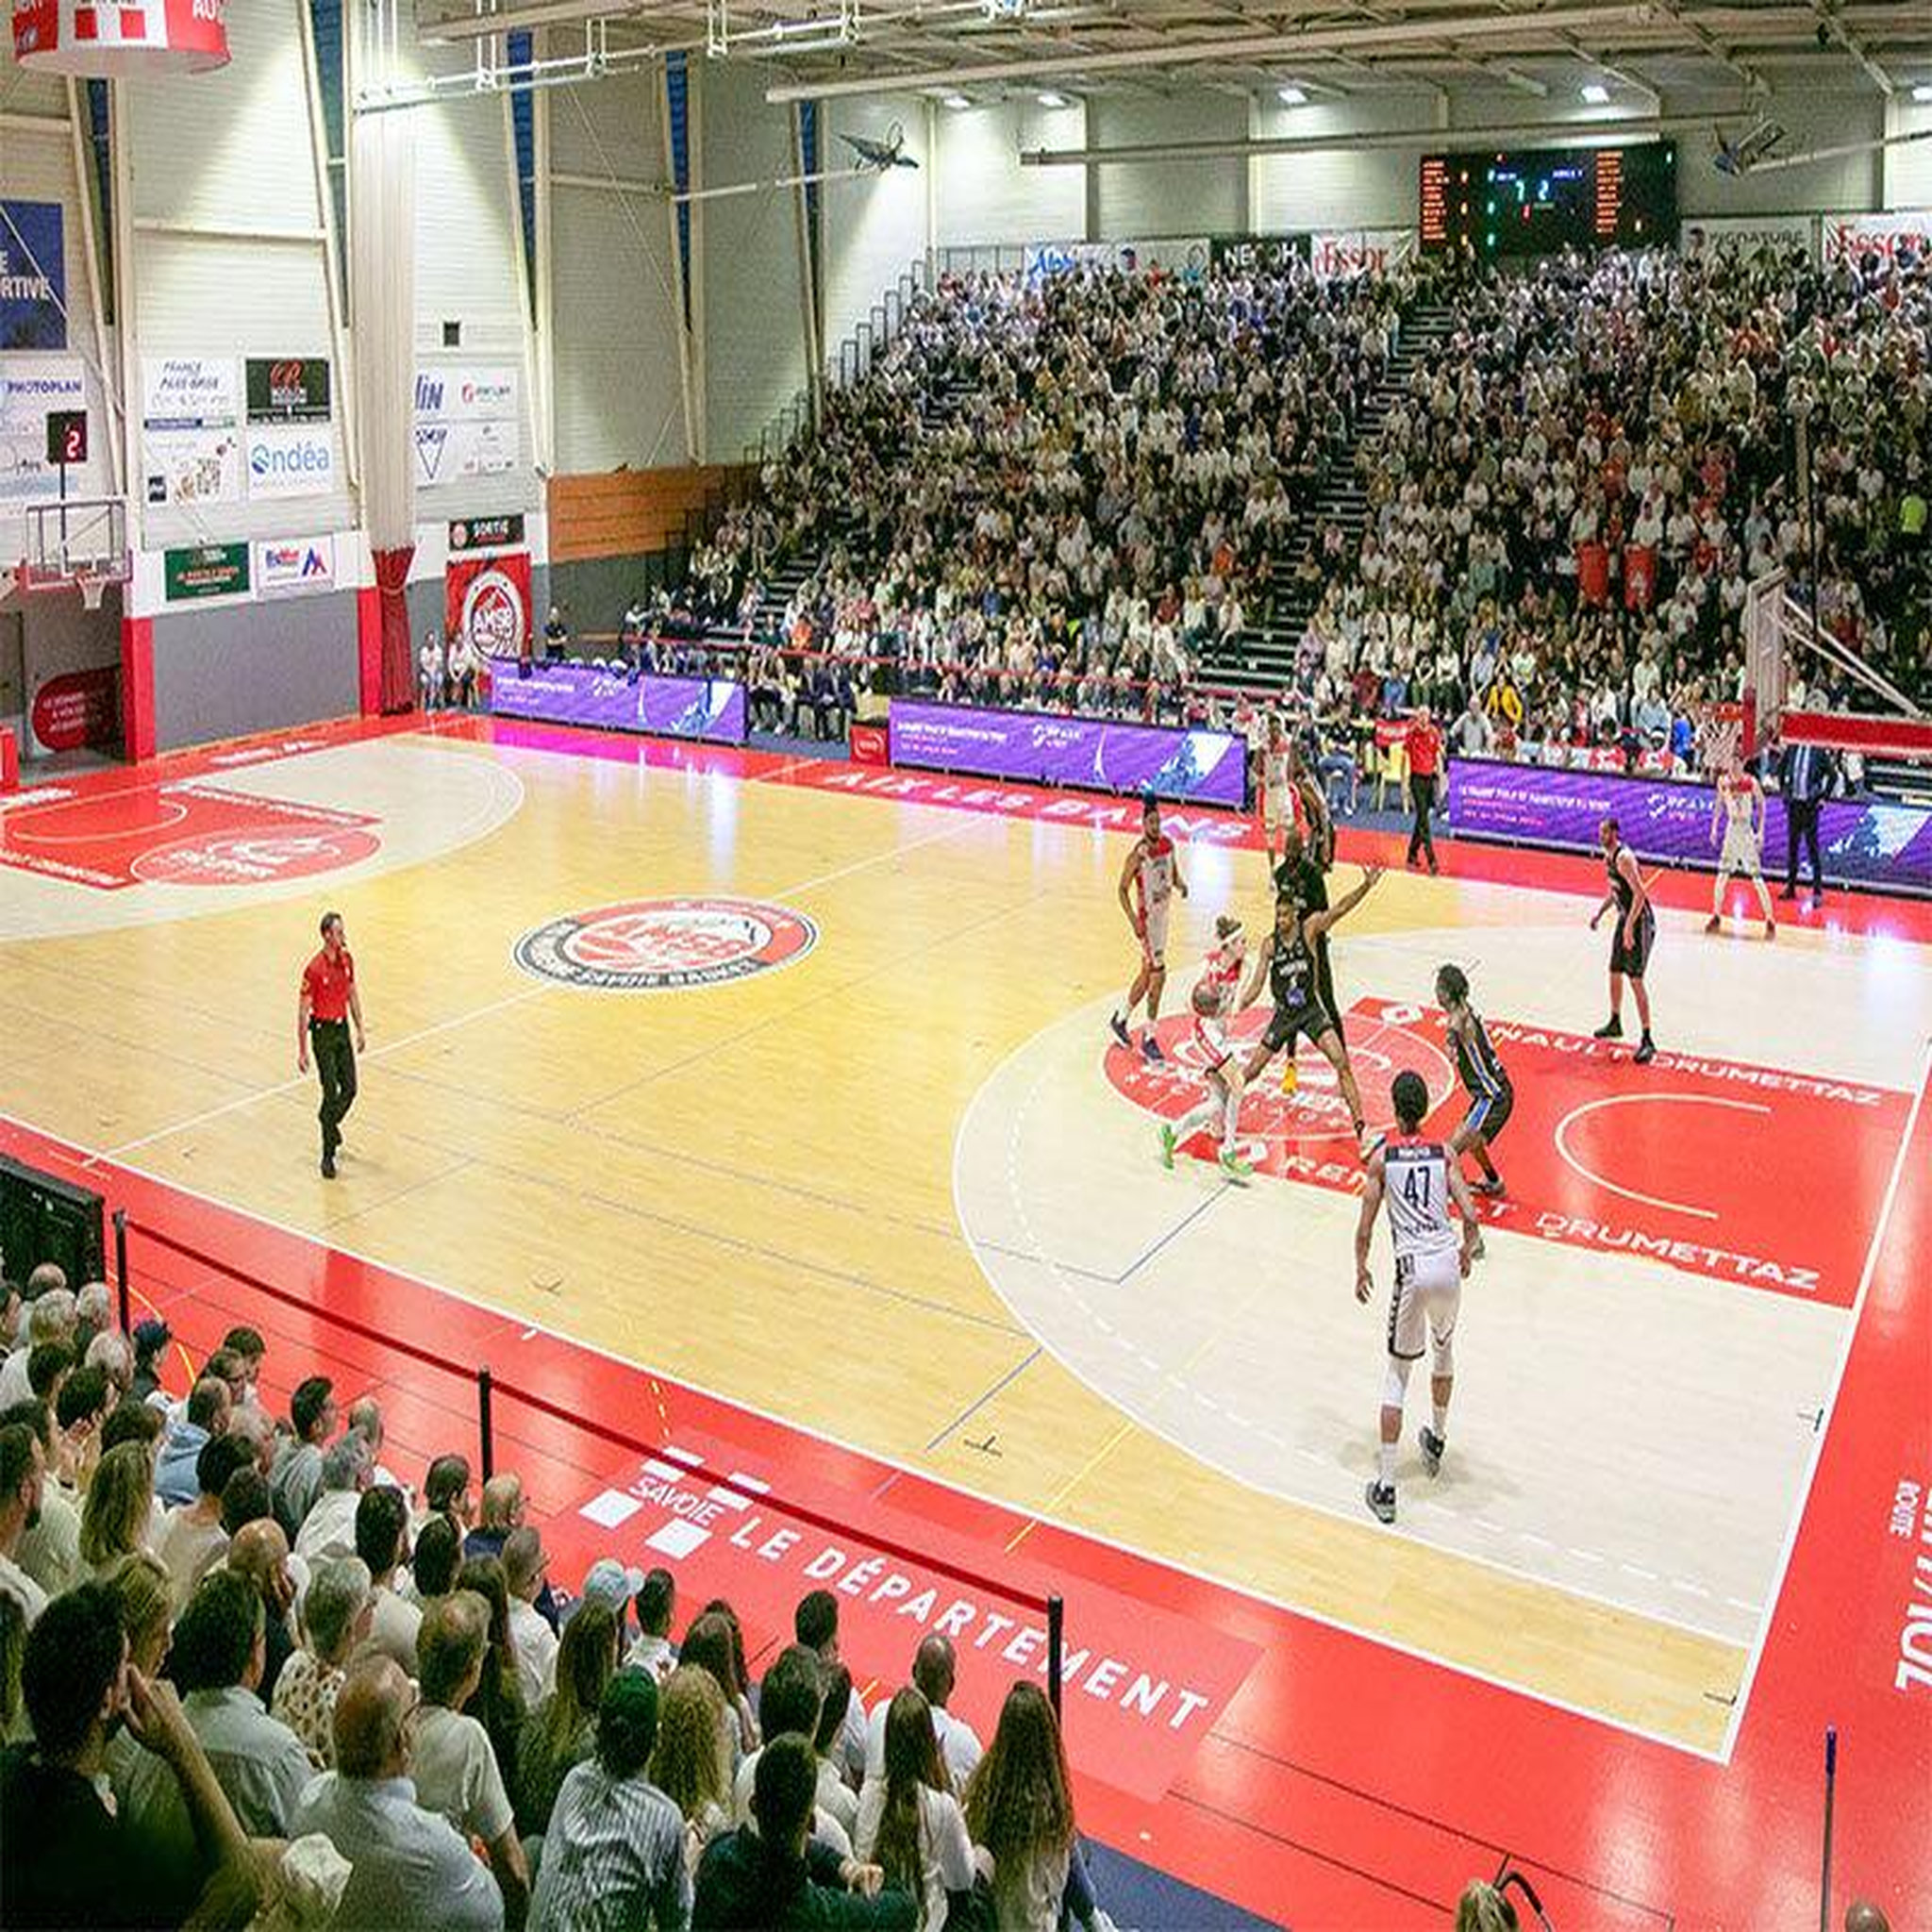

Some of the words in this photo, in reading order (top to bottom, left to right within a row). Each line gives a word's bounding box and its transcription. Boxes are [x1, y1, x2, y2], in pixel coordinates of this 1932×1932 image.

[8, 379, 82, 394] PHOTOPLAN
[824, 771, 931, 795] AIX
[931, 786, 1034, 809] LES
[1649, 1051, 1884, 1107] DRUMETTAZ
[1404, 1165, 1430, 1209] 47
[1535, 1211, 1821, 1291] DRUMETTAZ
[628, 1474, 725, 1526] SAVOIE
[729, 1516, 802, 1561] LE
[803, 1547, 1209, 1730] DÉPARTEMENT
